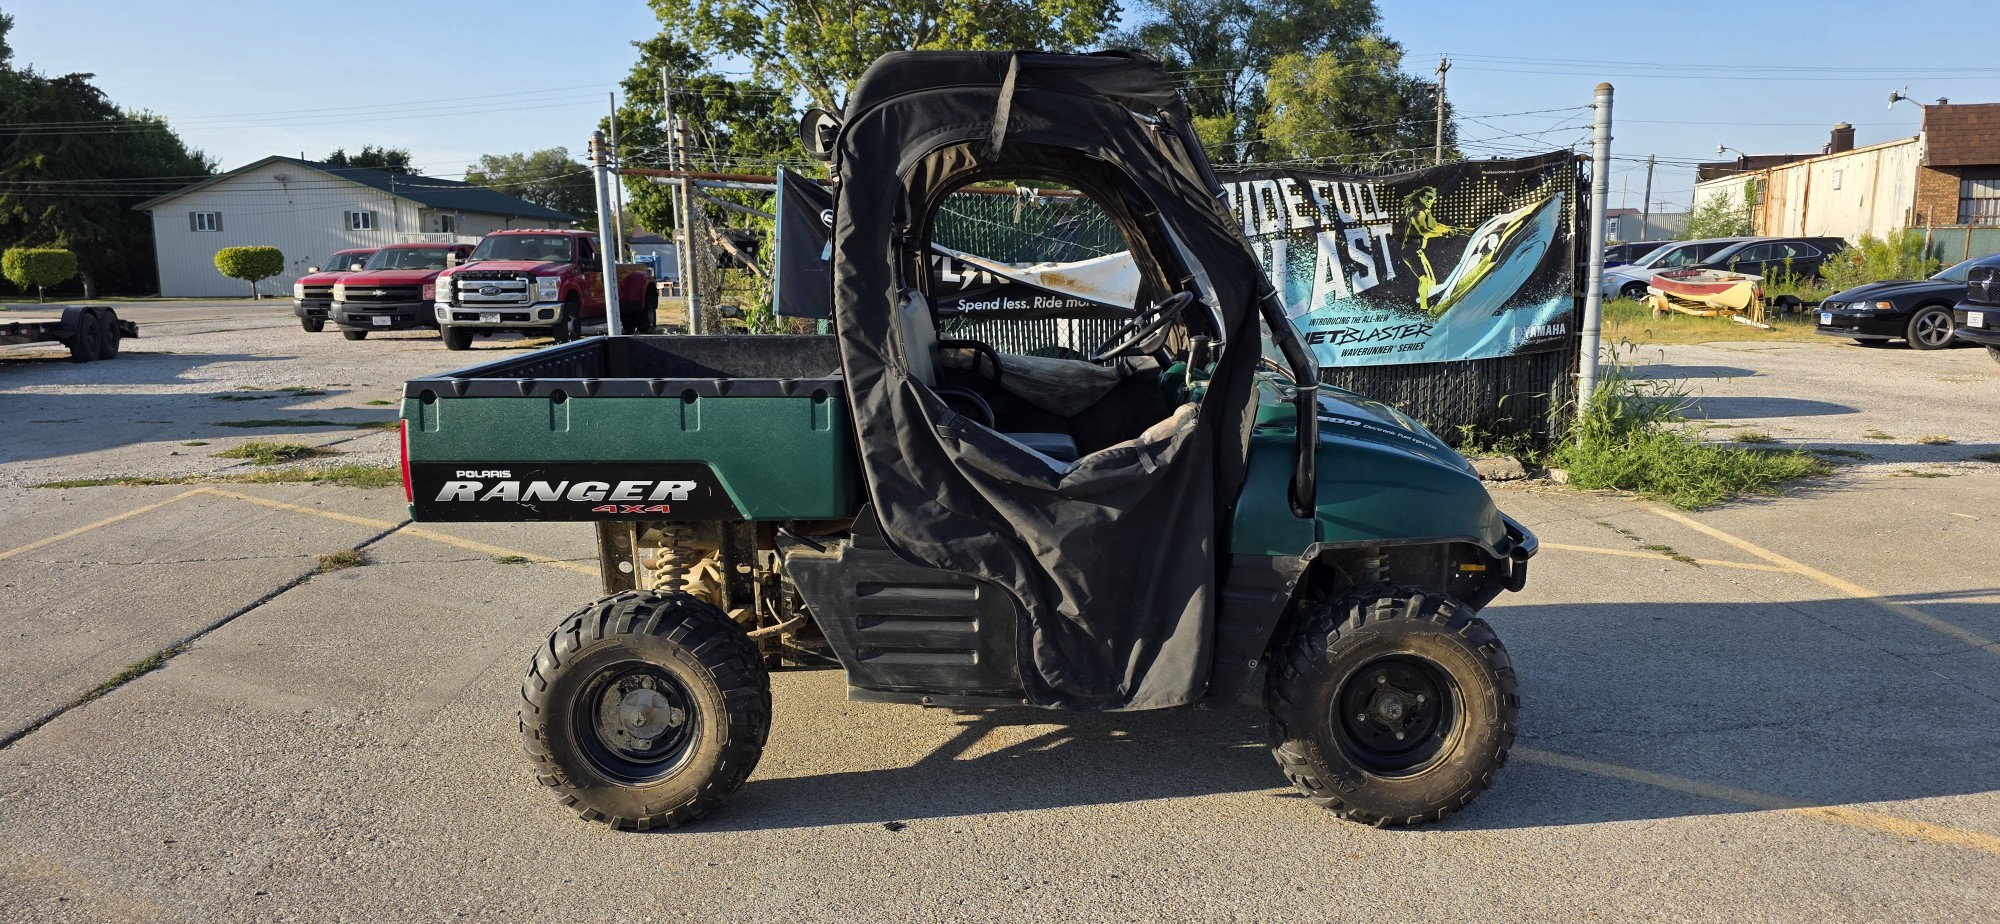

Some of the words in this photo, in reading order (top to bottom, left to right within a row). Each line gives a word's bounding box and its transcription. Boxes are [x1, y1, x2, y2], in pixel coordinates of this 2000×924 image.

[1309, 179, 1389, 225] FULL
[957, 297, 1000, 313] Spend
[1003, 296, 1030, 310] less.
[1033, 295, 1063, 309] Ride
[1066, 298, 1098, 308] mo
[1308, 316, 1350, 327] INTRODUCING
[1350, 315, 1362, 324] THE
[1361, 313, 1391, 323] ALL-NEW
[1524, 323, 1566, 338] YAMAHA
[1397, 341, 1426, 353] SERIES
[1362, 423, 1396, 436] Electronic
[1397, 432, 1412, 441] Fuel
[456, 469, 511, 478] POLARIS
[435, 479, 698, 502] RANGER
